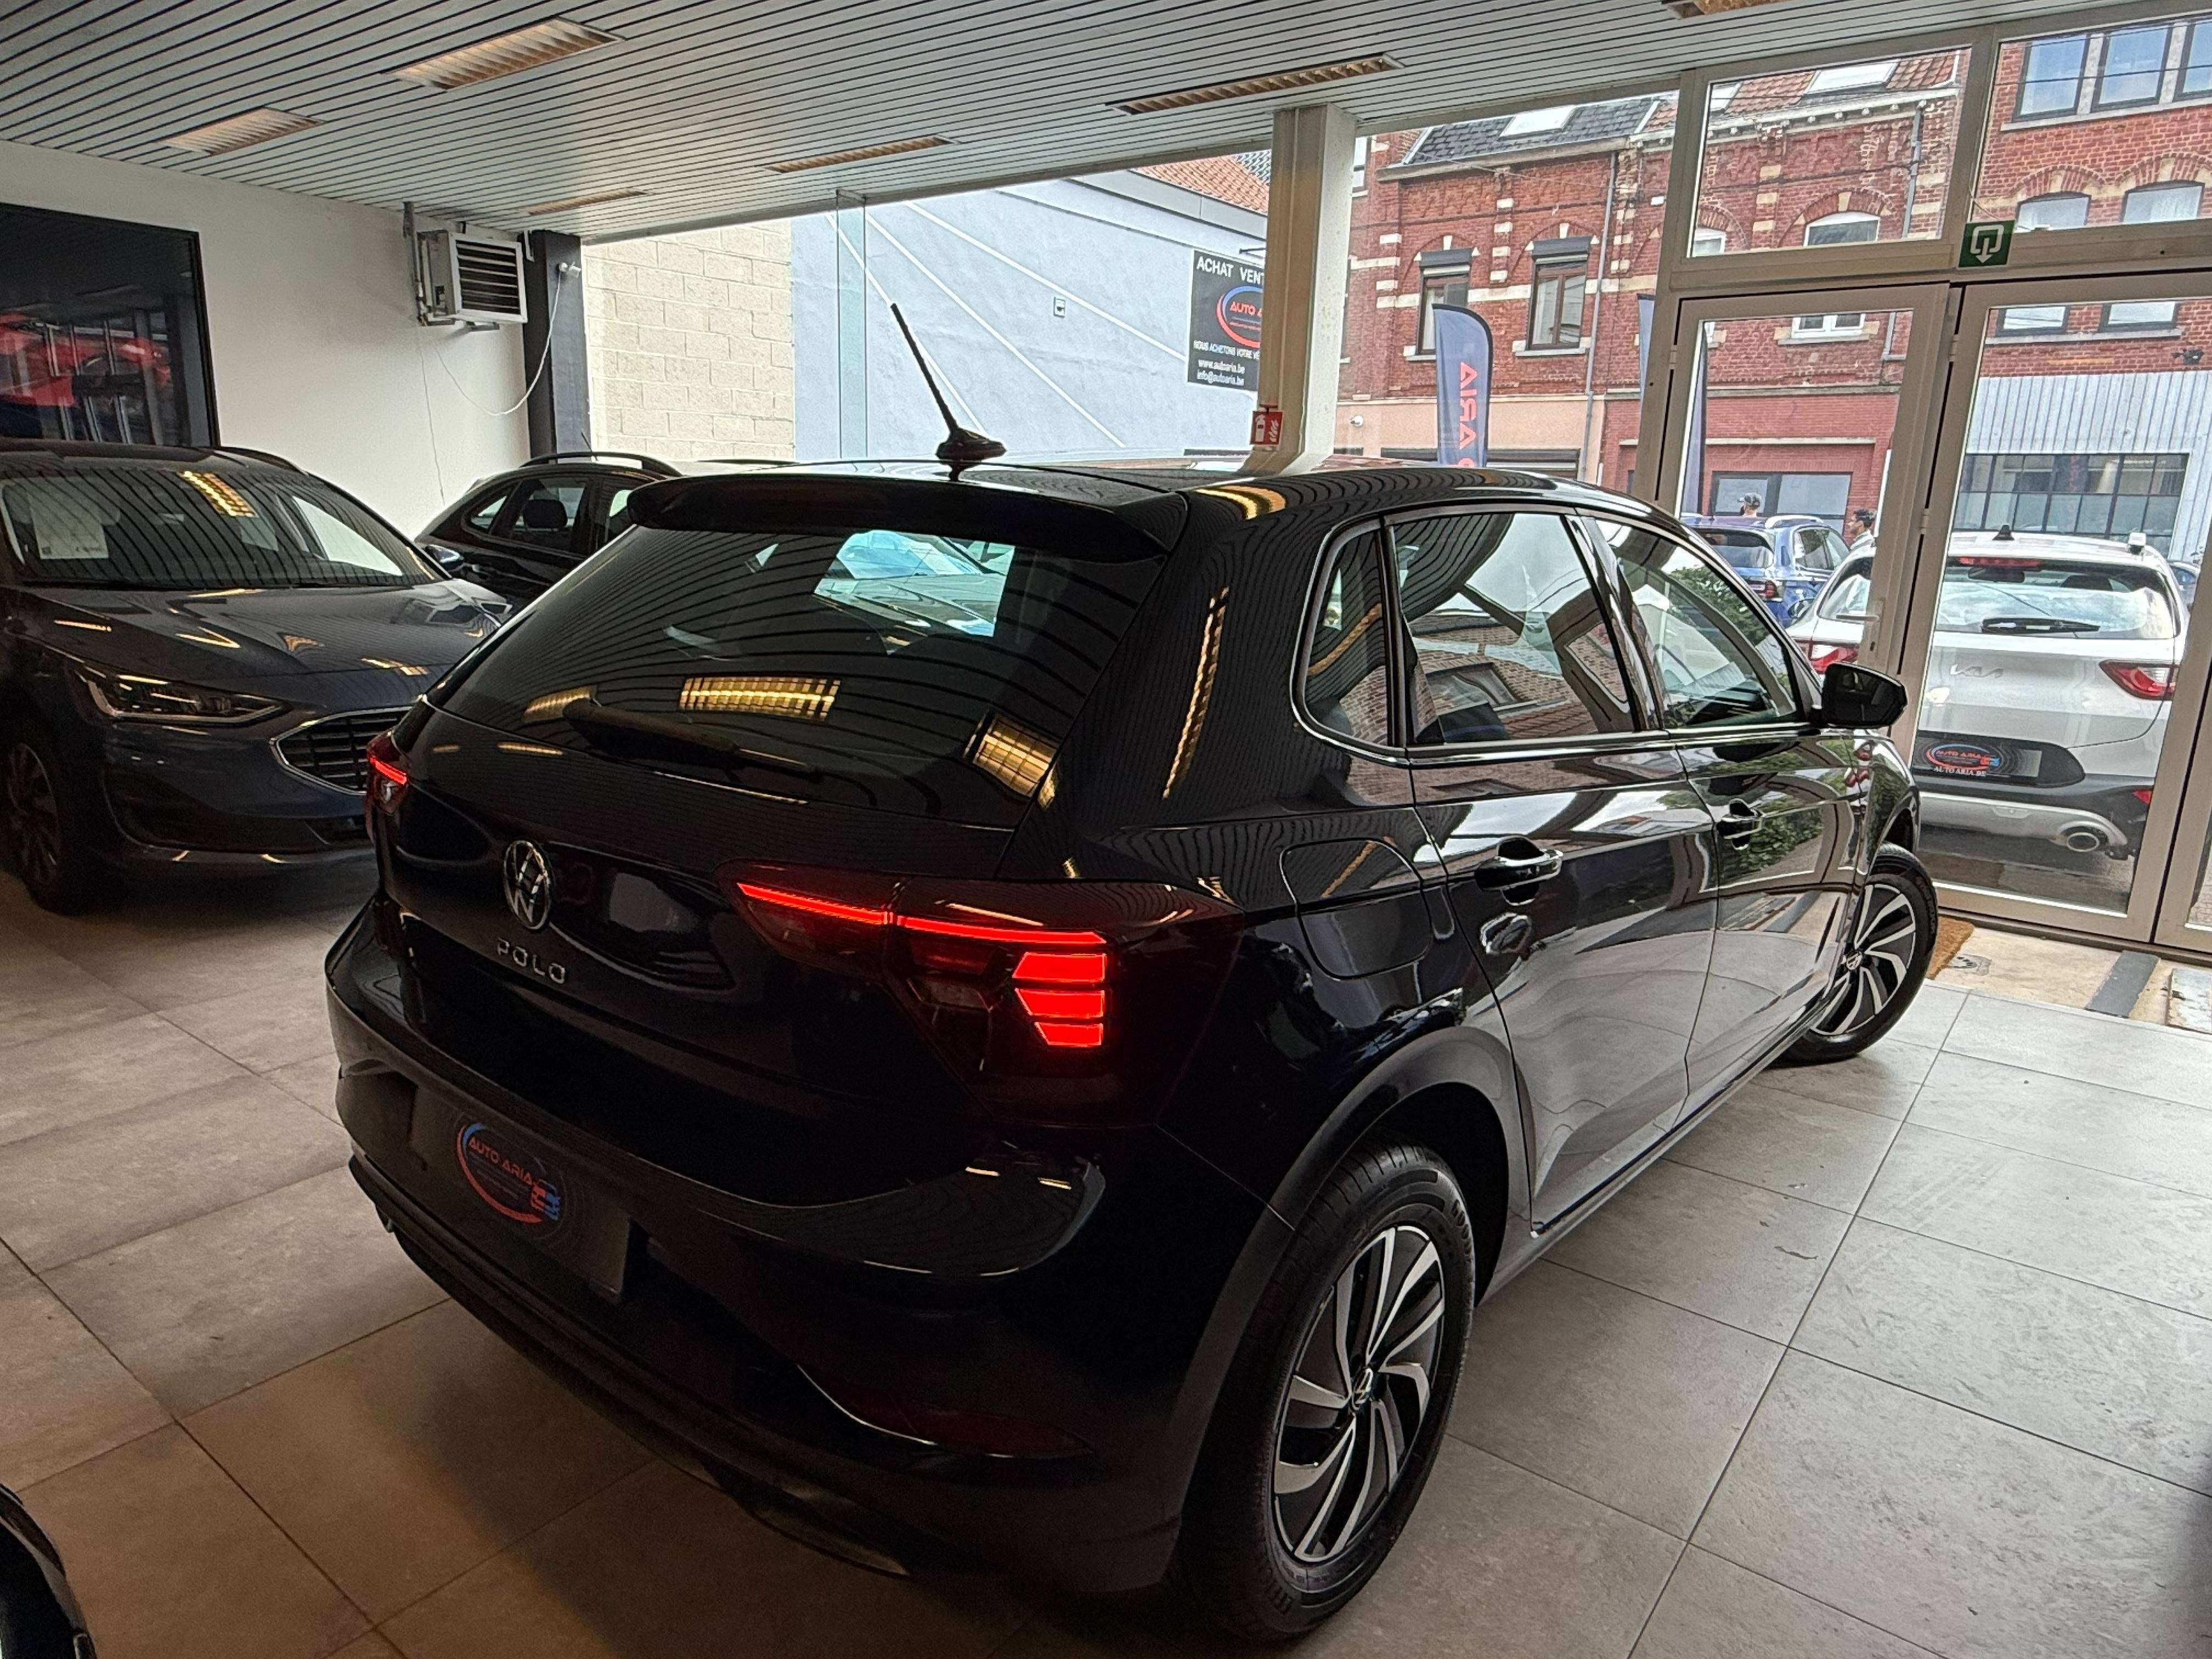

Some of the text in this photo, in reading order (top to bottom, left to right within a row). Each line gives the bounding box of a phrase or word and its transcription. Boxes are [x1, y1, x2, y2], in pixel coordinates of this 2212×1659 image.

[1197, 256, 1234, 277] ACHAT
[1230, 301, 1255, 316] AUTO
[496, 937, 565, 984] POLO
[469, 1136, 500, 1164] AUTO
[502, 1160, 532, 1186] ARIA
